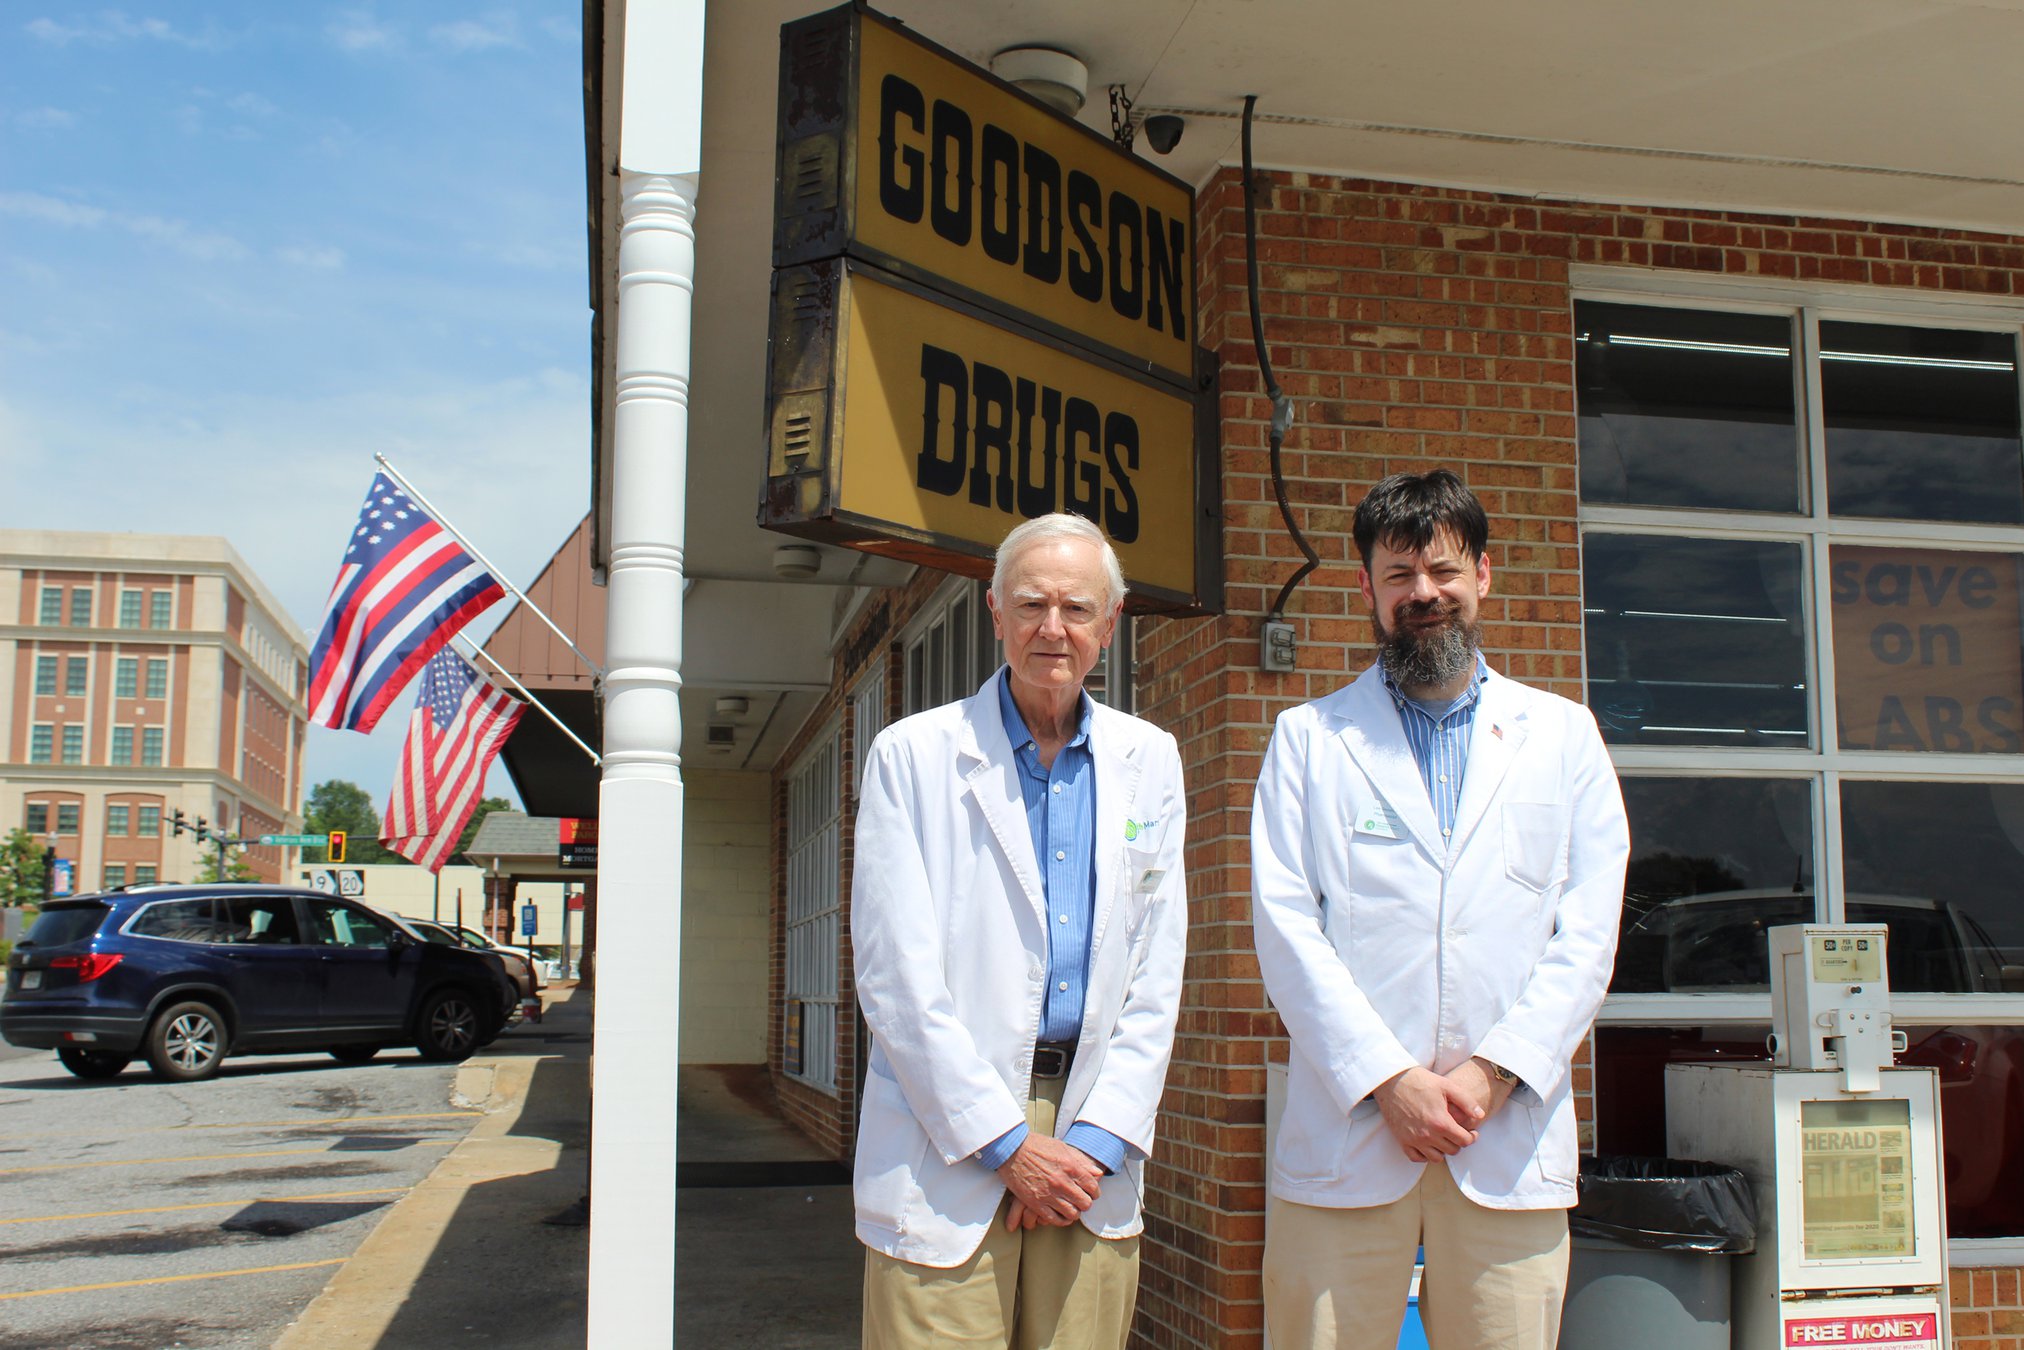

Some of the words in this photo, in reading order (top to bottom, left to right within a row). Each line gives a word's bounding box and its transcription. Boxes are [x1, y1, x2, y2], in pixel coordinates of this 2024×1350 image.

[878, 73, 1186, 342] GOODSON
[917, 343, 1140, 544] DRUGS
[1832, 560, 1999, 609] save
[1870, 621, 1962, 666] on
[316, 876, 326, 889] 9
[342, 876, 357, 892] 20
[1803, 1131, 1877, 1151] HERALD
[1791, 1324, 1847, 1343] FREE
[1852, 1320, 1926, 1339] MONEY
